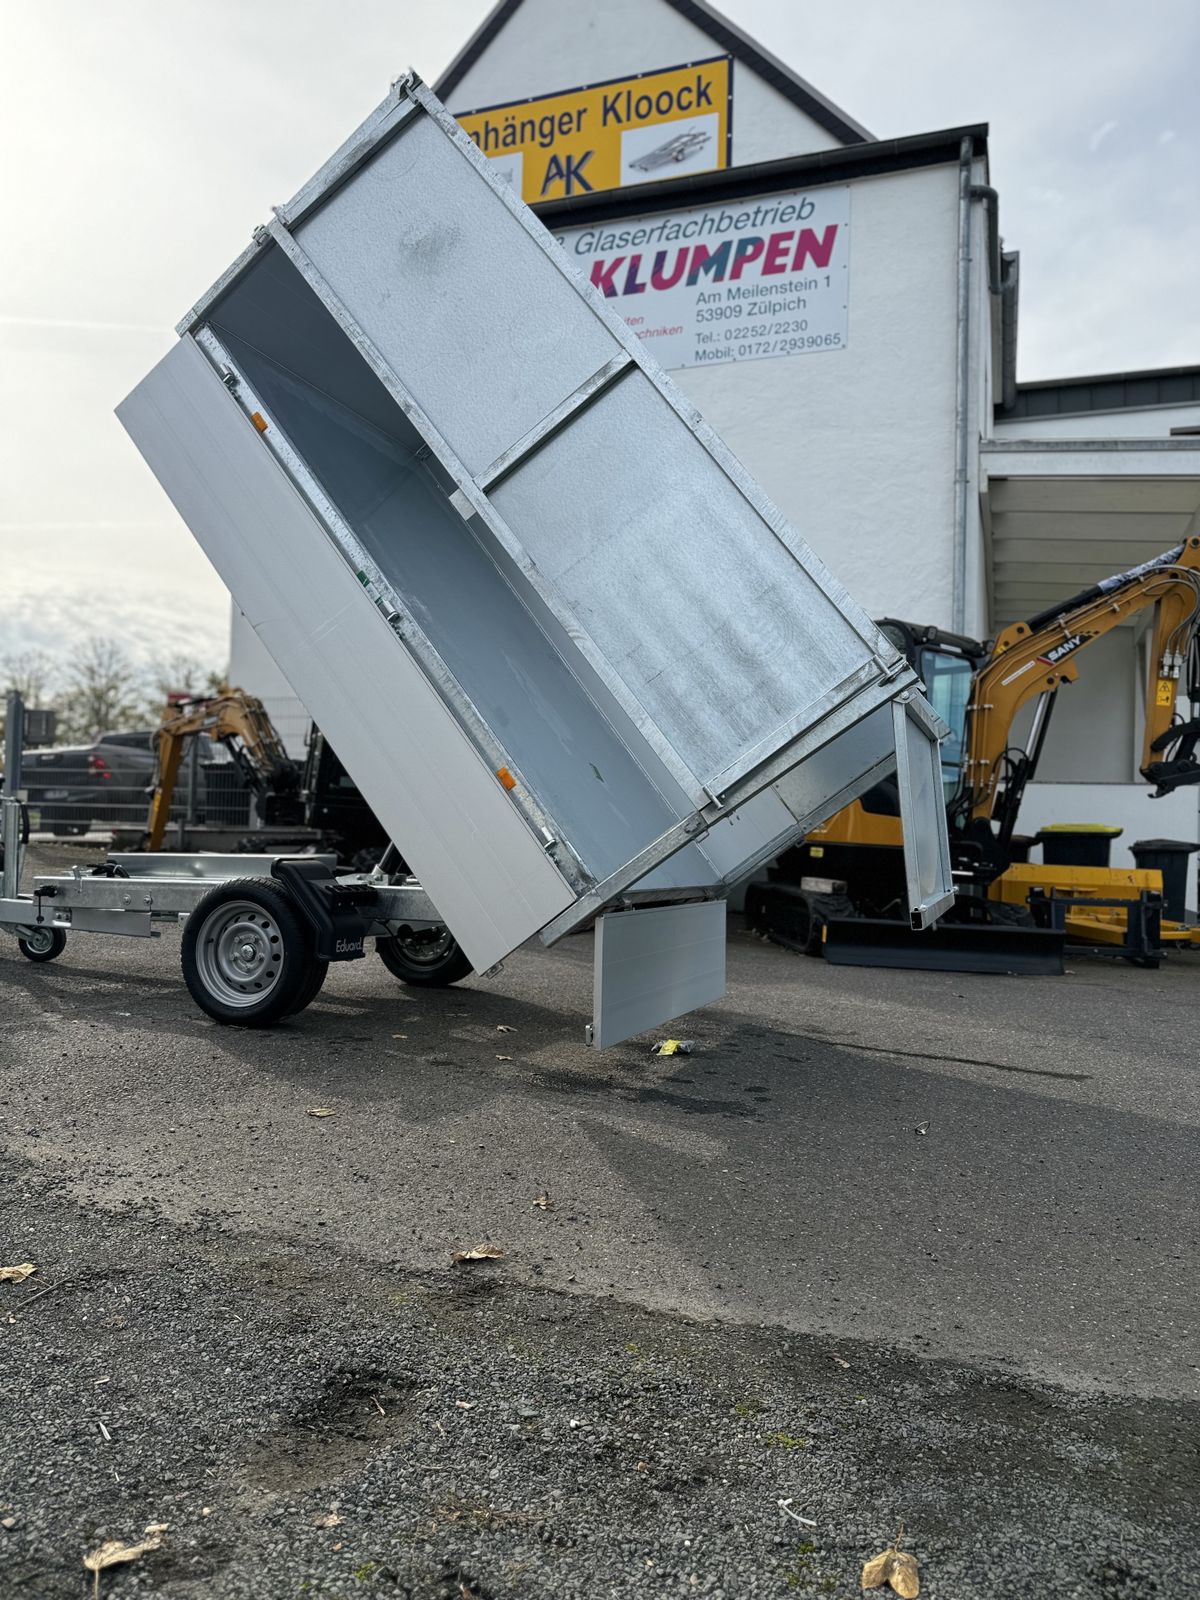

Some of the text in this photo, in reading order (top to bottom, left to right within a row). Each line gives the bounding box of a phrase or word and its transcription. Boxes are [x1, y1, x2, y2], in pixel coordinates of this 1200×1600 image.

[468, 74, 713, 150] nhänger Kloock
[540, 150, 595, 196] AK
[574, 196, 816, 256] Glaserfachbetrieb
[590, 224, 839, 298] KLUMPEN
[695, 275, 831, 306] Am Meilenstein 1
[695, 296, 807, 323] 53909 Zülpich
[695, 319, 809, 345] Tel.: 02252/2230
[694, 333, 841, 362] Mobil: 0172/2939065
[1048, 635, 1081, 661] SANY
[335, 936, 362, 953] Eduard
